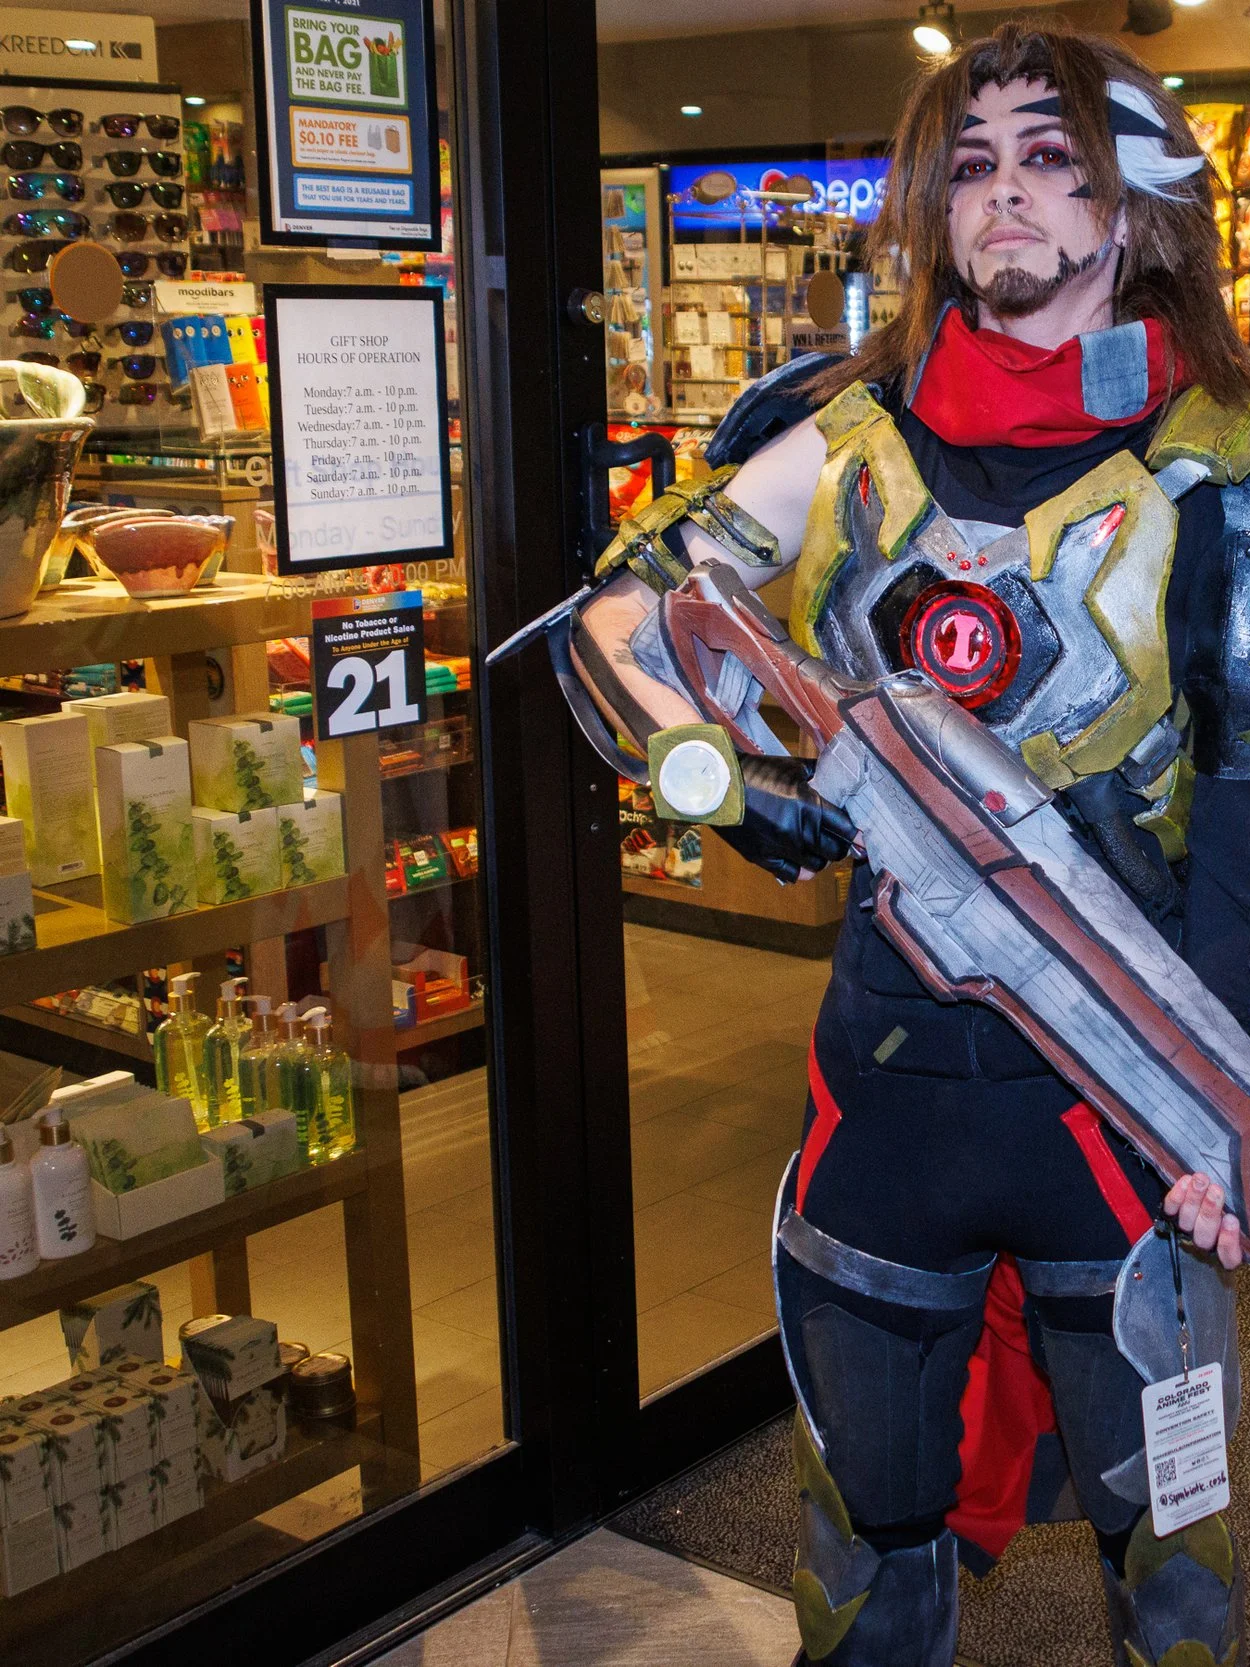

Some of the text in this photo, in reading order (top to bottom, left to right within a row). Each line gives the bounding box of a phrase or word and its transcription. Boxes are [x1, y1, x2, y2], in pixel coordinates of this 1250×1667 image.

[292, 17, 360, 36] BRING YOUR
[293, 31, 362, 70] BAG
[296, 67, 363, 81] AND NEVER PAY
[296, 77, 366, 96] THE BAG FEE.
[298, 118, 357, 132] MANDATORY
[299, 131, 359, 148] $0.10 FEE
[301, 183, 315, 192] THE
[316, 184, 330, 193] BEST
[331, 185, 346, 194] BAG
[347, 186, 353, 194] IS
[361, 187, 391, 196] REUSABLE
[392, 189, 406, 197] BAG
[302, 193, 317, 201] THAT
[318, 194, 331, 202] YOU
[332, 194, 342, 202] USE
[343, 195, 355, 203] FOR
[356, 195, 373, 204] YEARS
[374, 196, 387, 205] AND
[802, 177, 887, 218] peps
[178, 287, 235, 298] moodibars
[330, 335, 389, 347] GIFT SHOP
[297, 351, 421, 364] HOURS OF OPERATION
[355, 388, 375, 397] a.m.
[385, 385, 396, 396] 10
[398, 387, 418, 399] p.m.
[356, 405, 376, 414] a.m.
[386, 401, 397, 412] 10
[398, 403, 418, 415] p.m.
[363, 422, 383, 430] a.m.
[393, 418, 404, 429] 10
[406, 419, 426, 431] p.m.
[359, 438, 379, 447] a.m.
[389, 434, 400, 445] 10
[402, 435, 422, 447] p.m.
[354, 455, 373, 463] a.m.
[383, 451, 394, 462] 10
[396, 452, 417, 464] p.m.
[360, 472, 380, 480] a.m.
[389, 467, 400, 478] 10
[402, 468, 422, 481] p.m.
[357, 488, 377, 496] a.m.
[387, 483, 398, 495] 10
[400, 485, 420, 497] p.m.
[382, 509, 463, 541] Sundy
[264, 577, 311, 602] 7:00
[314, 570, 347, 594] AM
[435, 558, 466, 580] PM
[342, 621, 354, 630] No
[355, 618, 387, 629] Tobacco
[324, 624, 415, 643] Nicotine Product Sales
[340, 644, 361, 653] Anyone
[362, 641, 379, 649] Under
[391, 638, 402, 647] Age
[327, 649, 419, 736] 21
[1156, 1396, 1186, 1411] ANIME
[1187, 1385, 1212, 1399] FEST
[1157, 1381, 1209, 1405] COLORADO
[1155, 1418, 1192, 1436] CONVENTION
[1192, 1409, 1215, 1421] SAFETY
